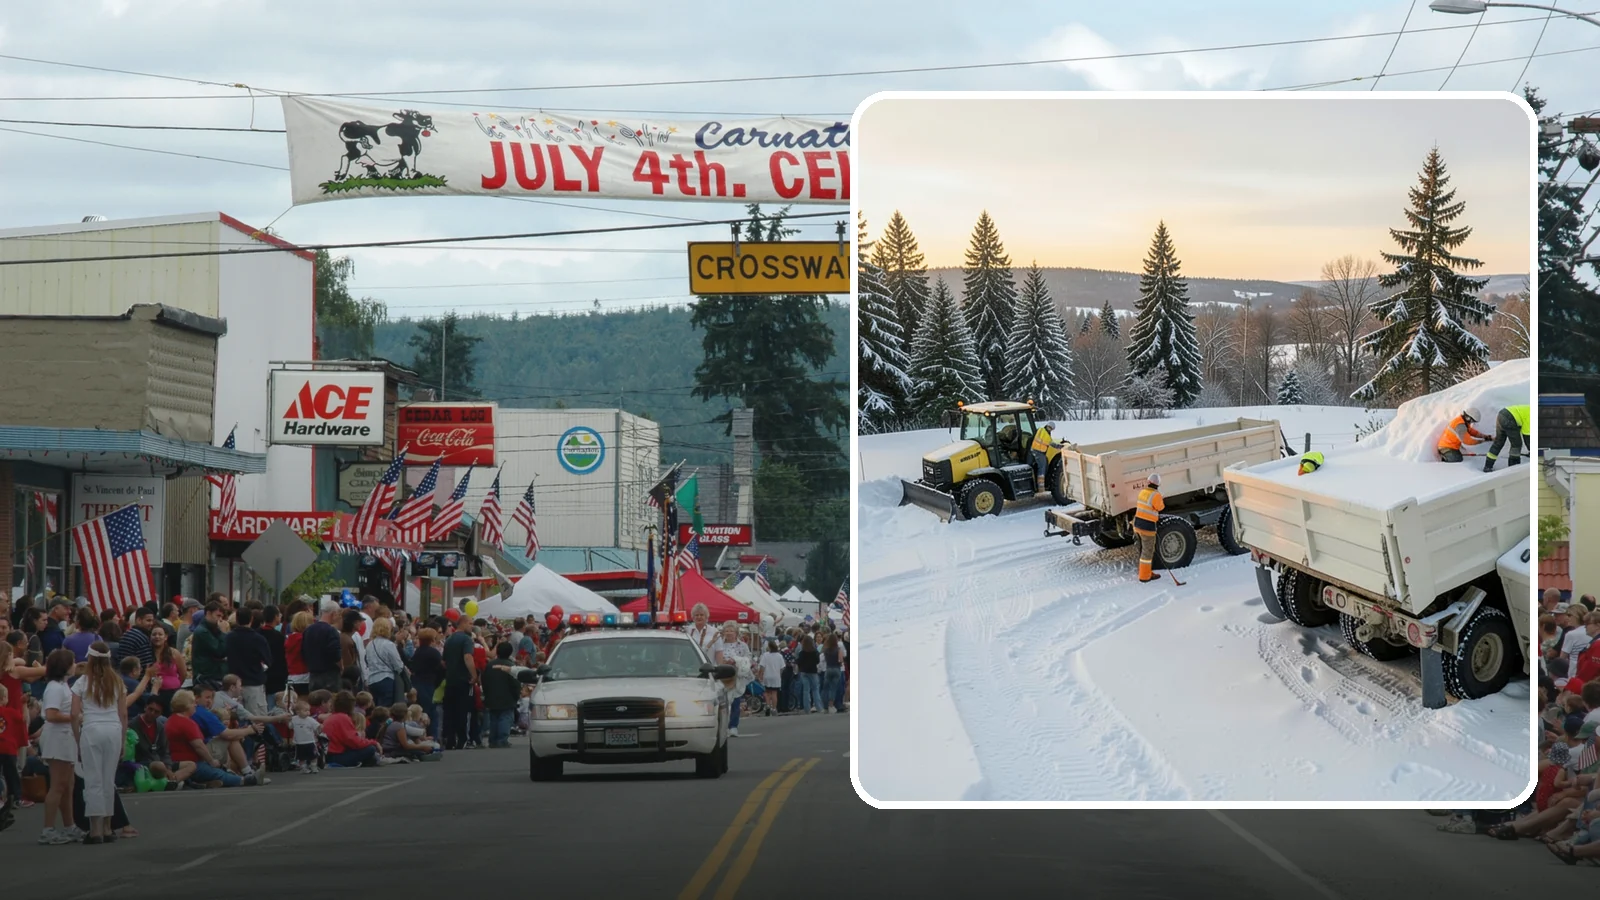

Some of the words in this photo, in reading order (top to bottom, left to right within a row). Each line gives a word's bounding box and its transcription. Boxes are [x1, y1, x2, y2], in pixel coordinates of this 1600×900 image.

[481, 141, 605, 192] JULY
[632, 150, 746, 197] 4th.
[697, 254, 850, 280] CROSSWA
[282, 380, 373, 420] ACE
[405, 409, 452, 422] CEDAR
[461, 409, 485, 422] LOG
[283, 421, 370, 436] Hardware
[416, 428, 477, 447] Coca-Cola
[353, 467, 386, 480] Simpl
[83, 485, 93, 494] St.
[95, 485, 124, 494] Vincent
[126, 486, 136, 495] de
[137, 486, 155, 495] Paul
[688, 526, 741, 535] CRNATION
[699, 535, 730, 543] GLASS
